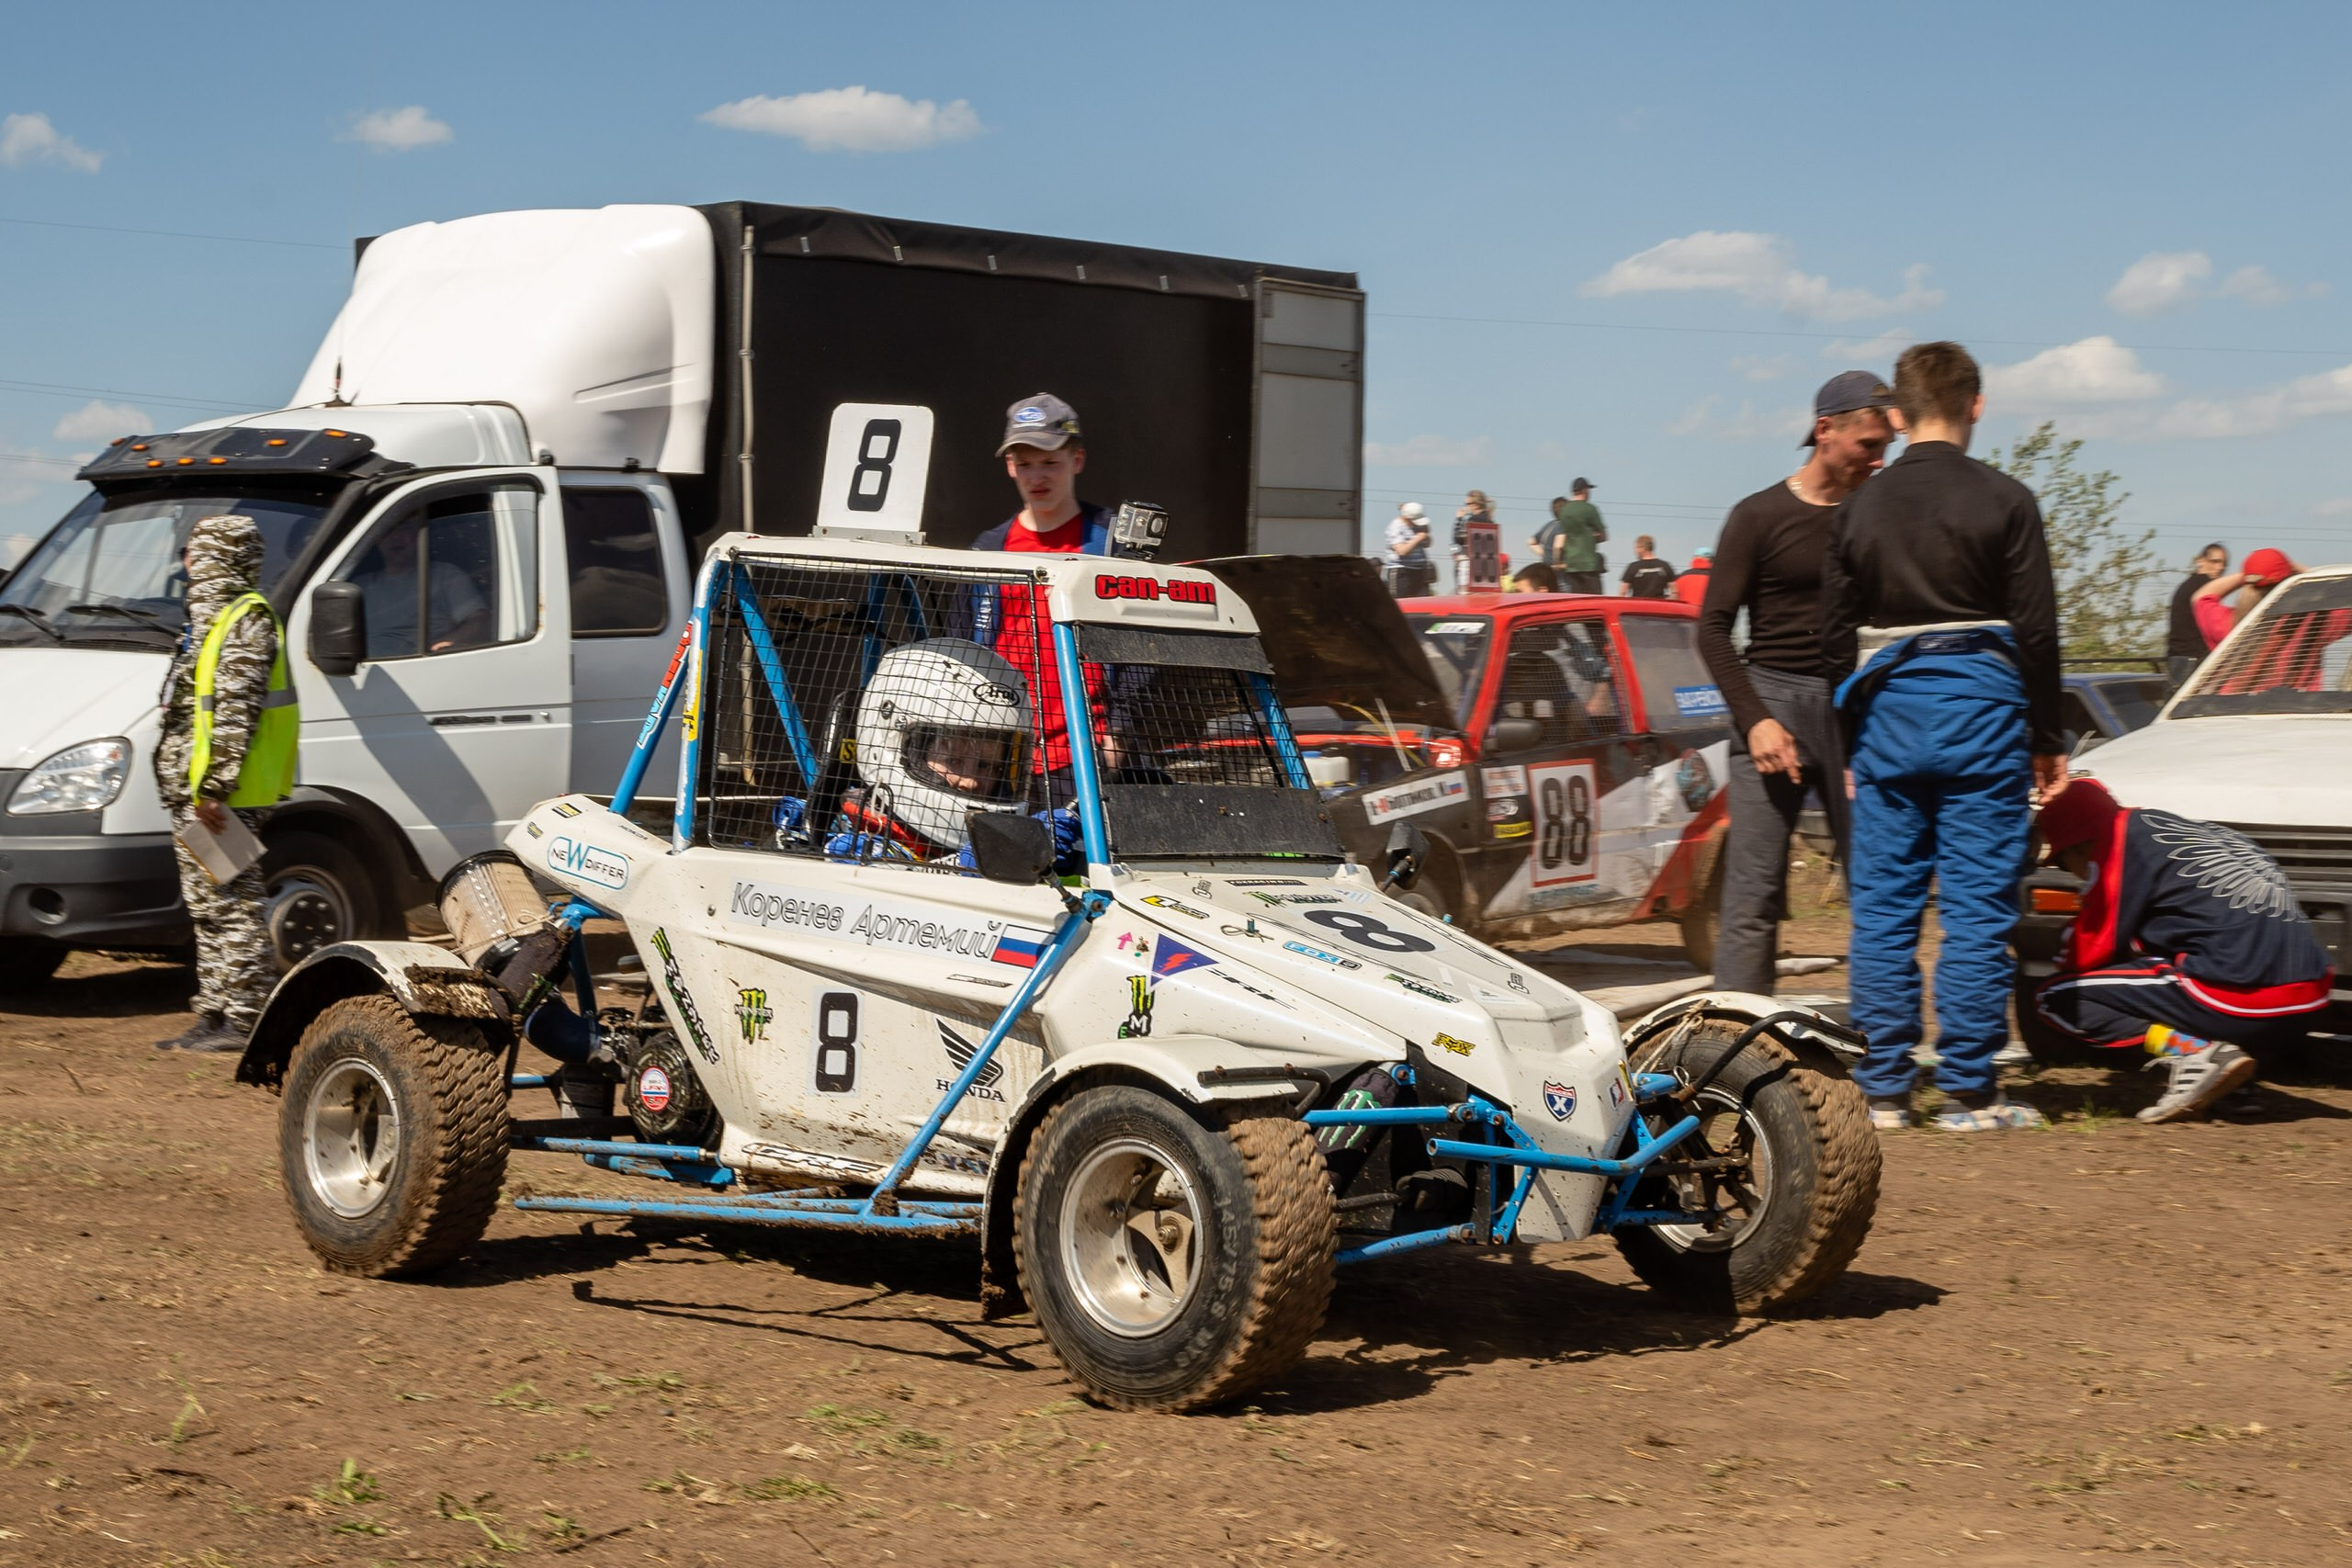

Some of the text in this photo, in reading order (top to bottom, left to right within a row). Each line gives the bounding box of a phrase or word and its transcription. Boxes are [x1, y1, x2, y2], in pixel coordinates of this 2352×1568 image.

[847, 419, 901, 512] 8
[1095, 574, 1216, 604] can-am
[1541, 775, 1591, 870] 88
[584, 858, 625, 880] DIFFER
[730, 882, 1003, 959] Коренев Артемий
[1304, 909, 1436, 953] 8
[816, 992, 858, 1092] 8
